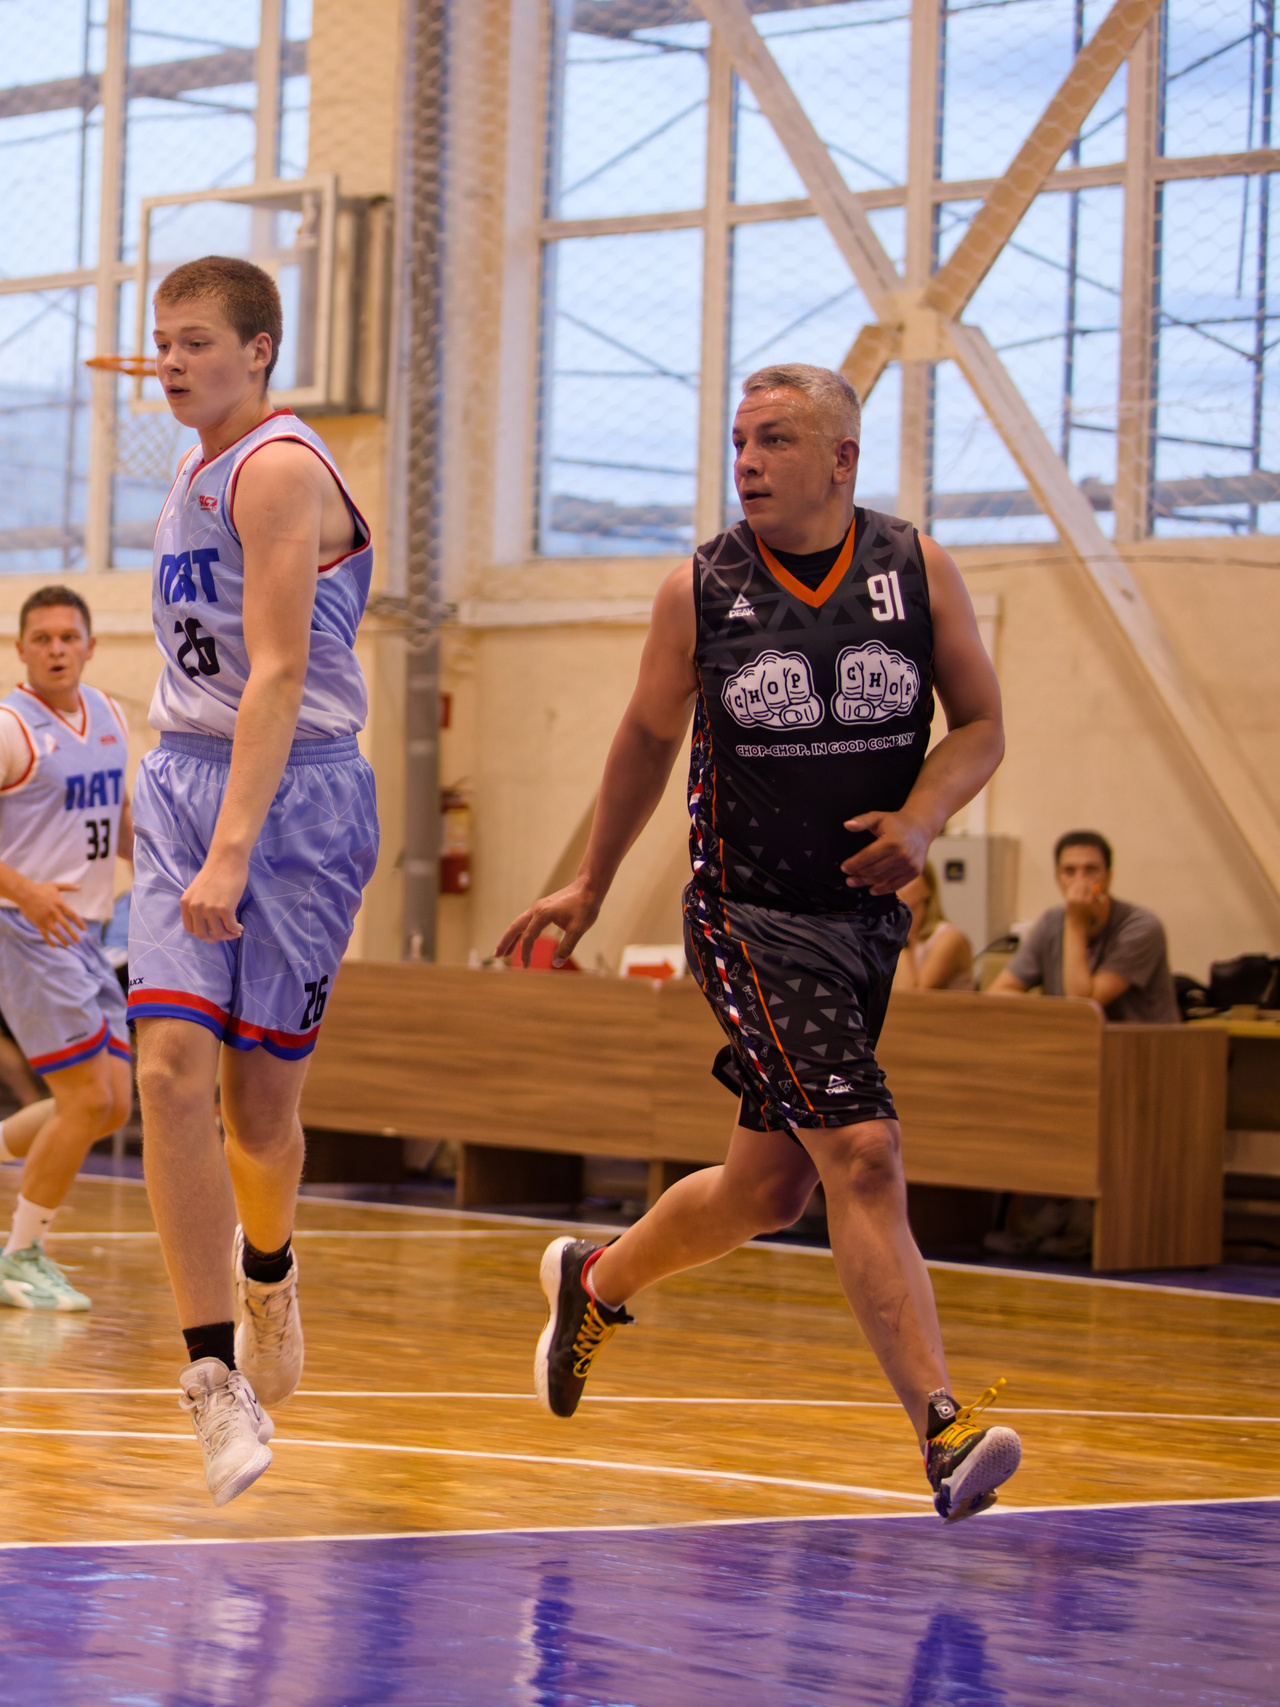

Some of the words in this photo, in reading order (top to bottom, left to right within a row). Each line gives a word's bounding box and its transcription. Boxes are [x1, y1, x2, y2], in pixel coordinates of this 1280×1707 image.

[728, 606, 756, 619] PEAK
[867, 570, 906, 622] 91
[174, 617, 220, 679] 26
[734, 672, 801, 709] CHOP
[847, 665, 912, 697] CHOP
[811, 742, 828, 756] IN
[828, 739, 867, 755] GOOD
[85, 818, 111, 861] 33
[299, 974, 328, 1030] 26
